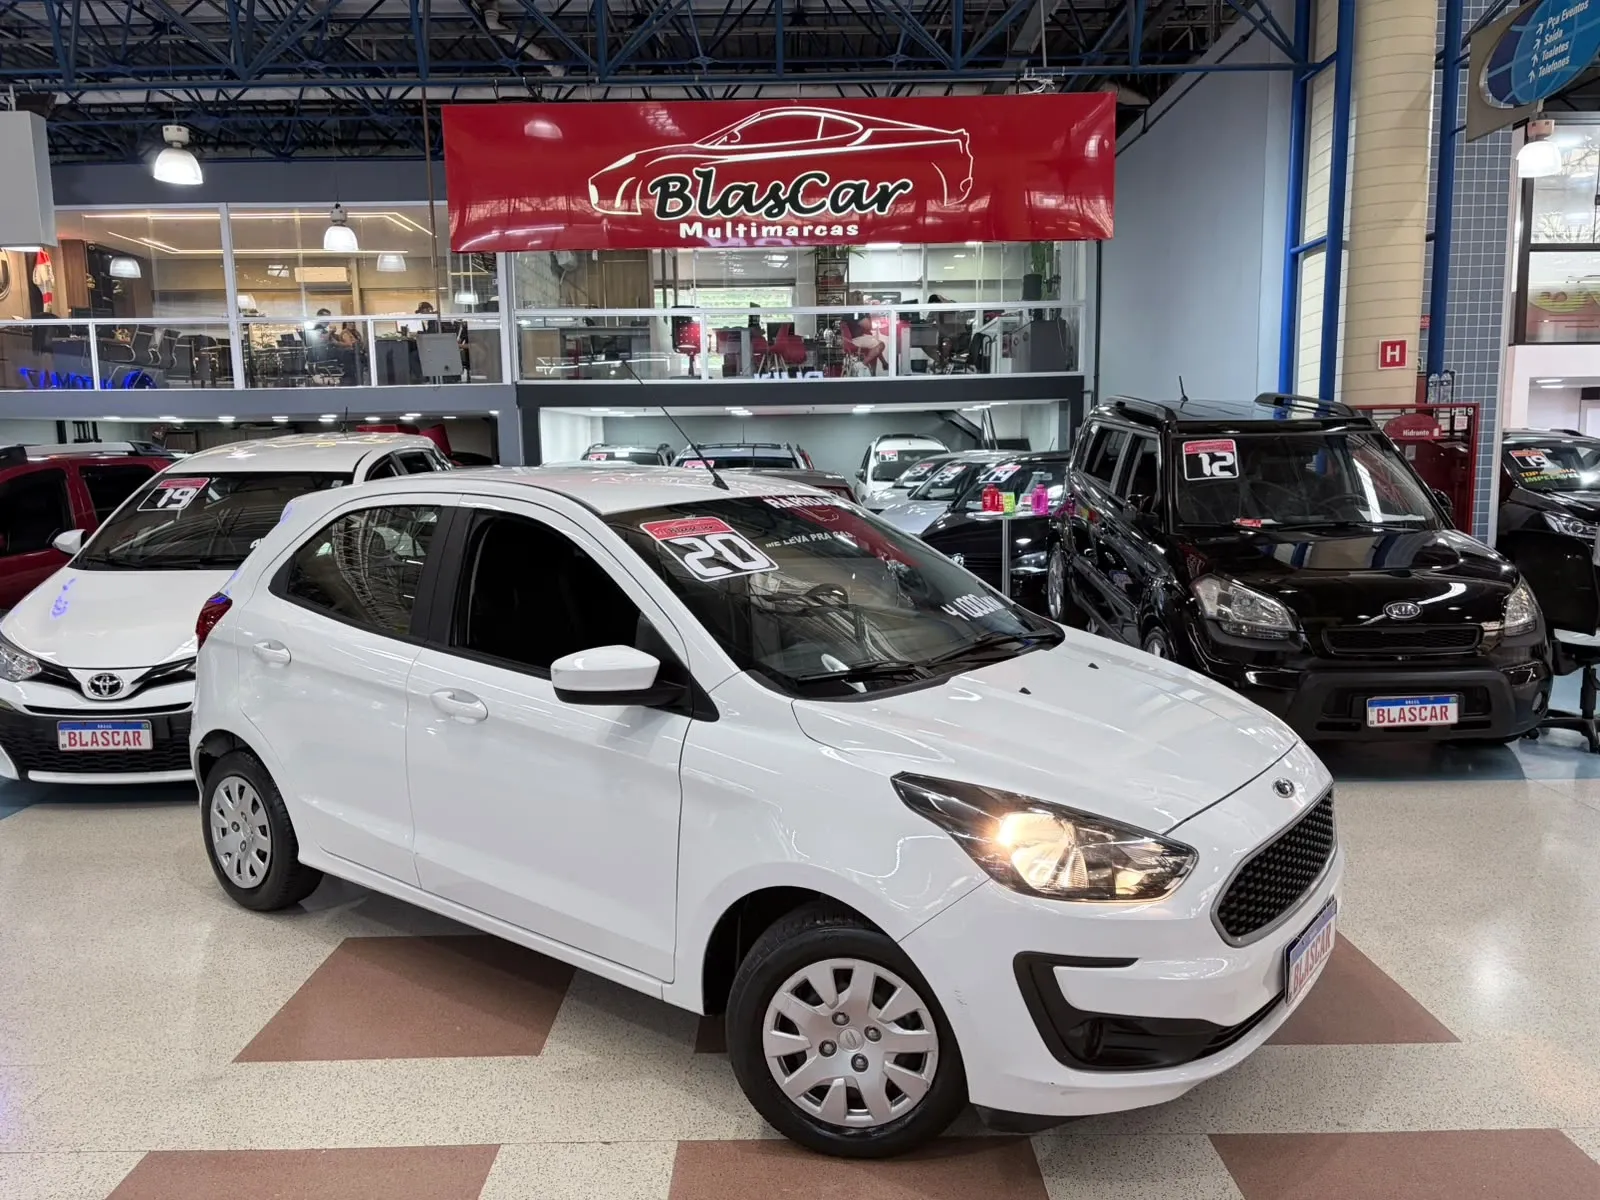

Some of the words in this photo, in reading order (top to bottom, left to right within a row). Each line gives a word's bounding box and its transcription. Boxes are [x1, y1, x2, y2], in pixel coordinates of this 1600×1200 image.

[1547, 15, 1560, 29] Pça
[1561, 0, 1589, 21] Eventos
[1544, 29, 1563, 45] Saída
[1542, 41, 1569, 60] Toaletes
[1539, 56, 1569, 77] Telefones
[649, 167, 912, 220] BlasCar
[679, 222, 859, 239] Multimarcas
[1386, 345, 1400, 362] H
[1198, 452, 1234, 477] 12
[157, 487, 197, 508] 19
[783, 534, 809, 546] LEVA
[810, 532, 832, 543] PRA
[669, 533, 771, 577] 20
[1376, 705, 1449, 724] BLASCAR
[68, 731, 142, 747] BLASCAR
